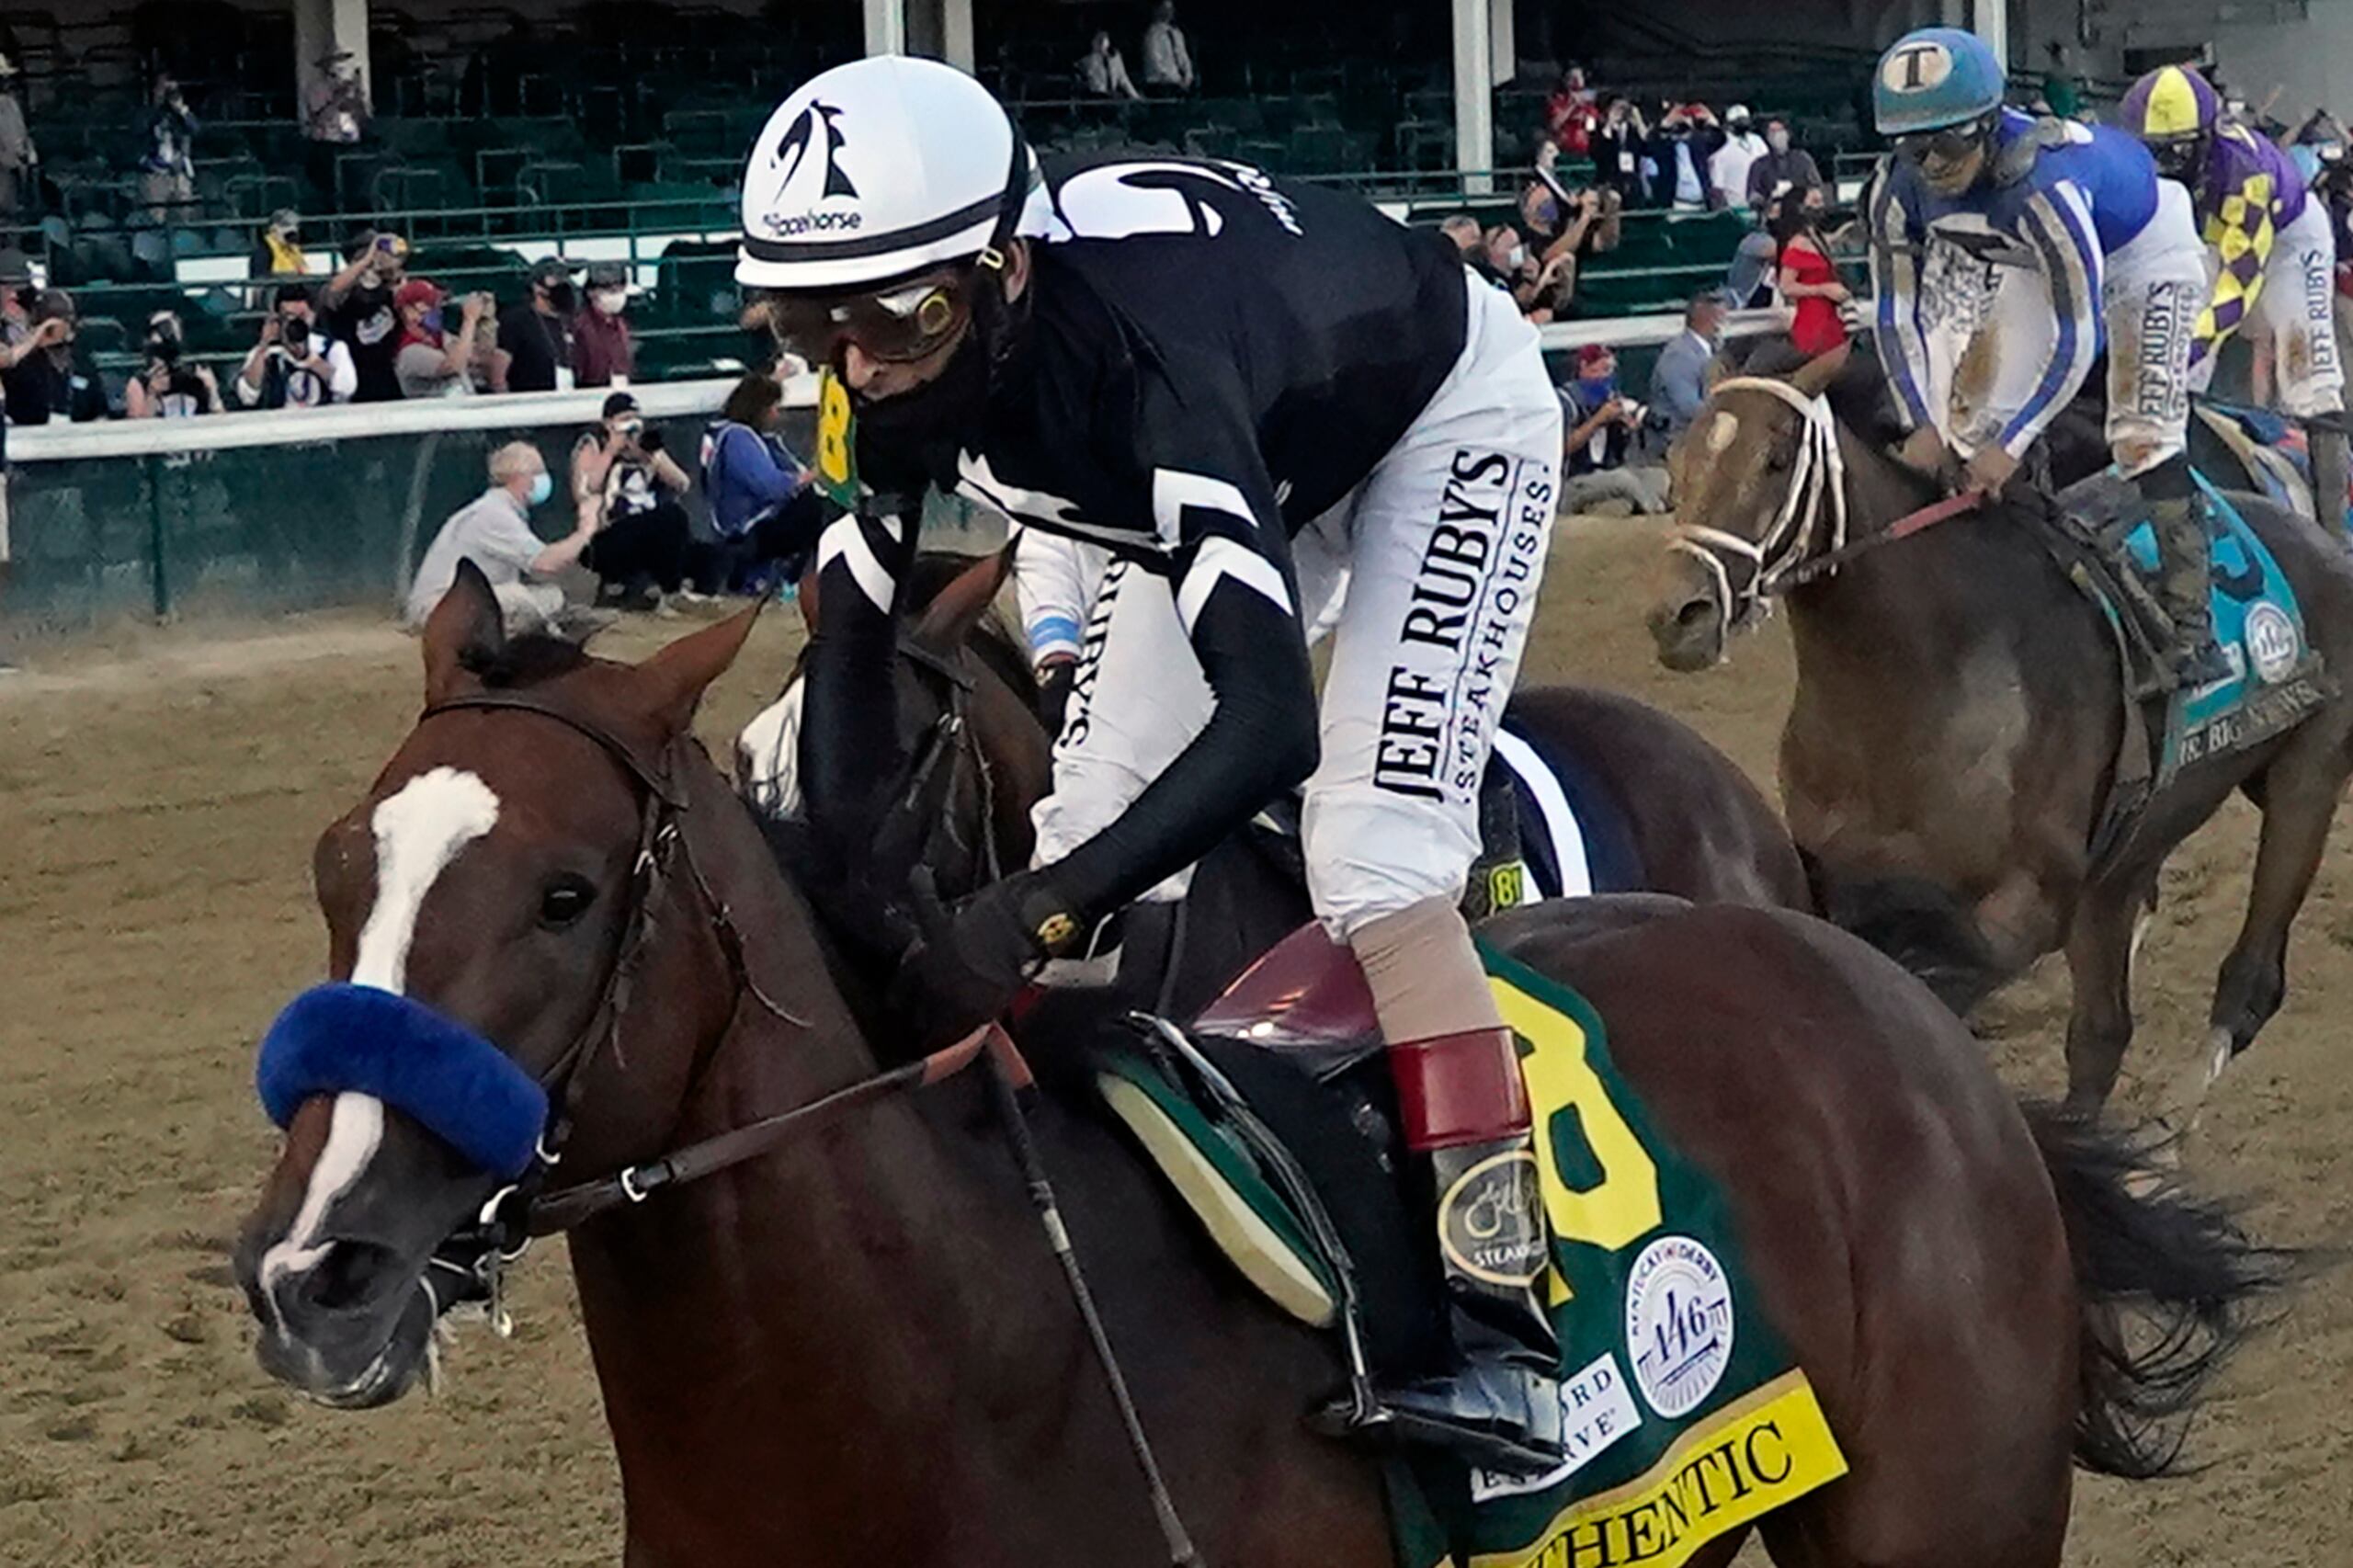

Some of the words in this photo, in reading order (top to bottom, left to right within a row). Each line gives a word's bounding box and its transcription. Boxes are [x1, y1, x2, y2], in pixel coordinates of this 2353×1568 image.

[1894, 46, 1938, 90] T
[2140, 280, 2174, 365] RUBY'S
[2311, 327, 2336, 376] JEFF
[2138, 368, 2168, 416] EFF
[1400, 449, 1509, 653] RUBY'S
[1373, 665, 1448, 804] JEFF
[1655, 1290, 1707, 1366] 146
